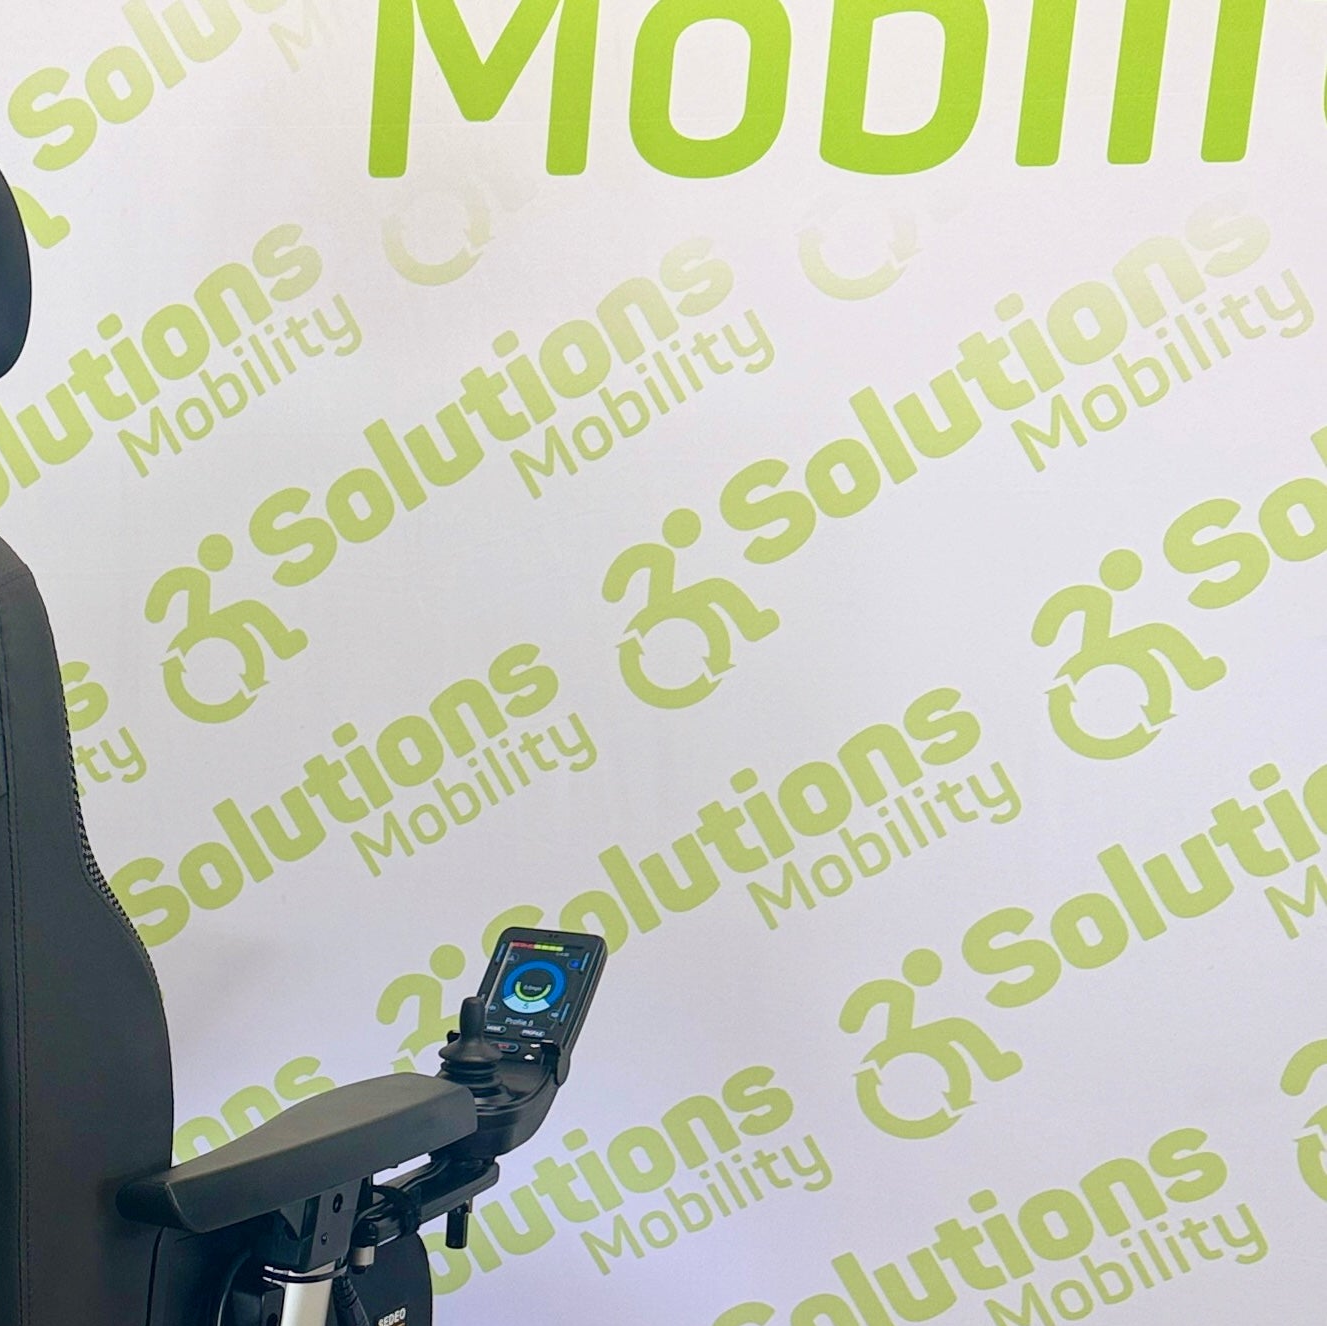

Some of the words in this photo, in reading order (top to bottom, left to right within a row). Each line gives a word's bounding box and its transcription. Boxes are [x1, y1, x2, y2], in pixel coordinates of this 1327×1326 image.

[117, 293, 363, 478] Mobility
[249, 236, 734, 587] Solutions
[510, 308, 775, 500] Mobility
[719, 197, 1270, 564] Solutions
[1010, 269, 1315, 472] Mobility
[108, 643, 560, 948] Solutions
[350, 713, 598, 876] Mobility
[746, 761, 1022, 930] Mobility
[581, 1135, 833, 1275] Mobility
